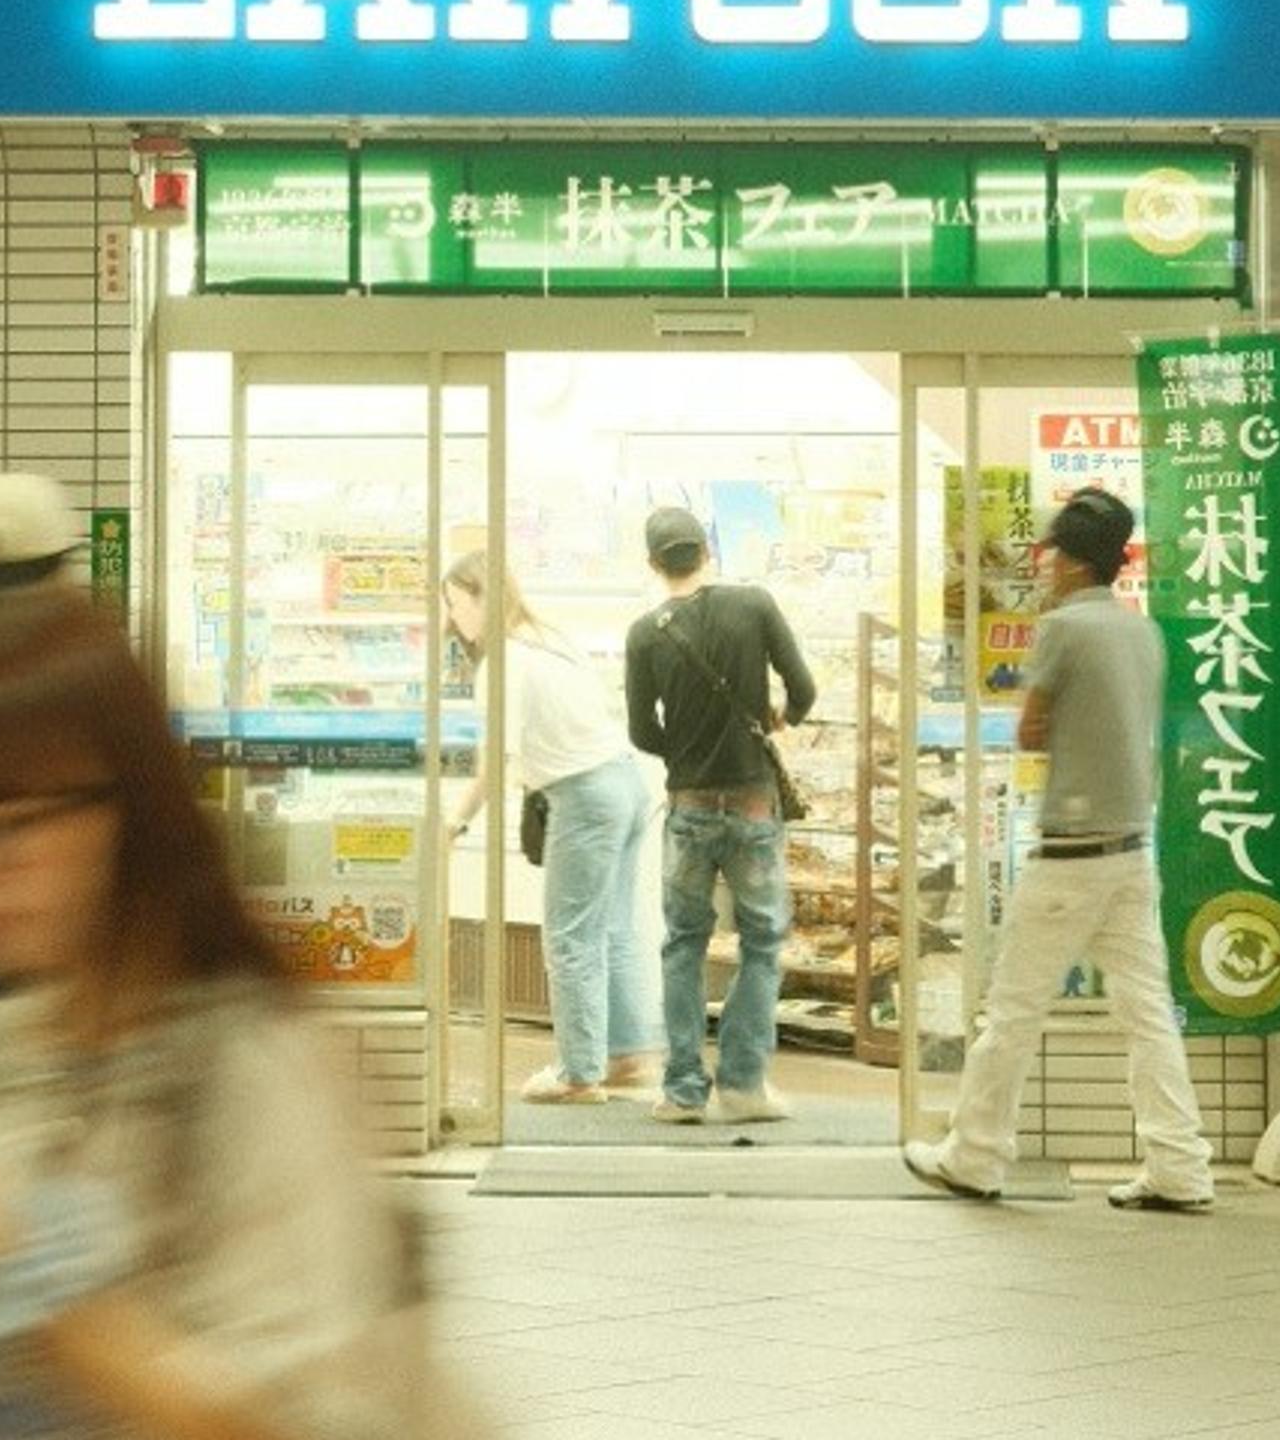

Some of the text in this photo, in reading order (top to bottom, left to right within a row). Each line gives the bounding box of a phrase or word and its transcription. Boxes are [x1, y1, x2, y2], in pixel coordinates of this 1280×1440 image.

[557, 175, 899, 254] 抹茶フェア
